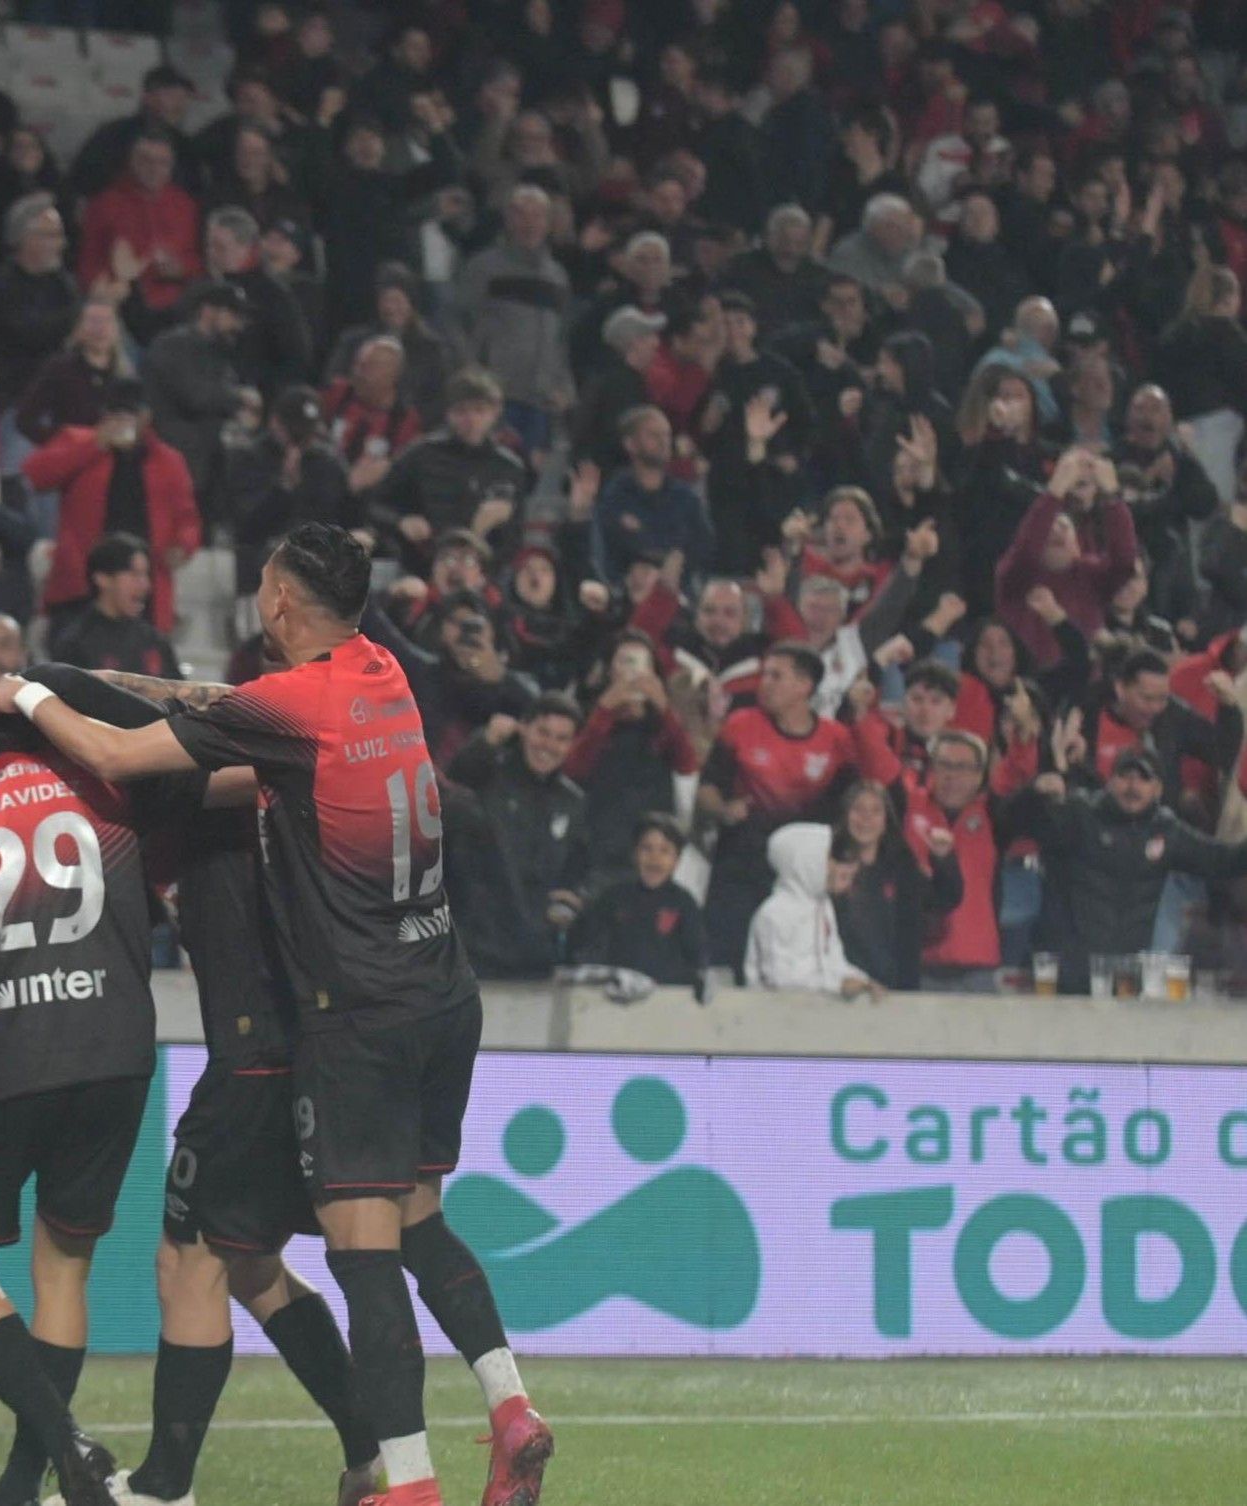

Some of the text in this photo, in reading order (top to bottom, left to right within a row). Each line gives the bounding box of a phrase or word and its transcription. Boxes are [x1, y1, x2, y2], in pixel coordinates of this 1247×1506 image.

[344, 736, 389, 764] LUIZ
[386, 760, 444, 902] 19
[19, 965, 107, 1005] inter
[829, 1082, 1173, 1167] Cartão
[829, 1182, 1247, 1341] TOD
